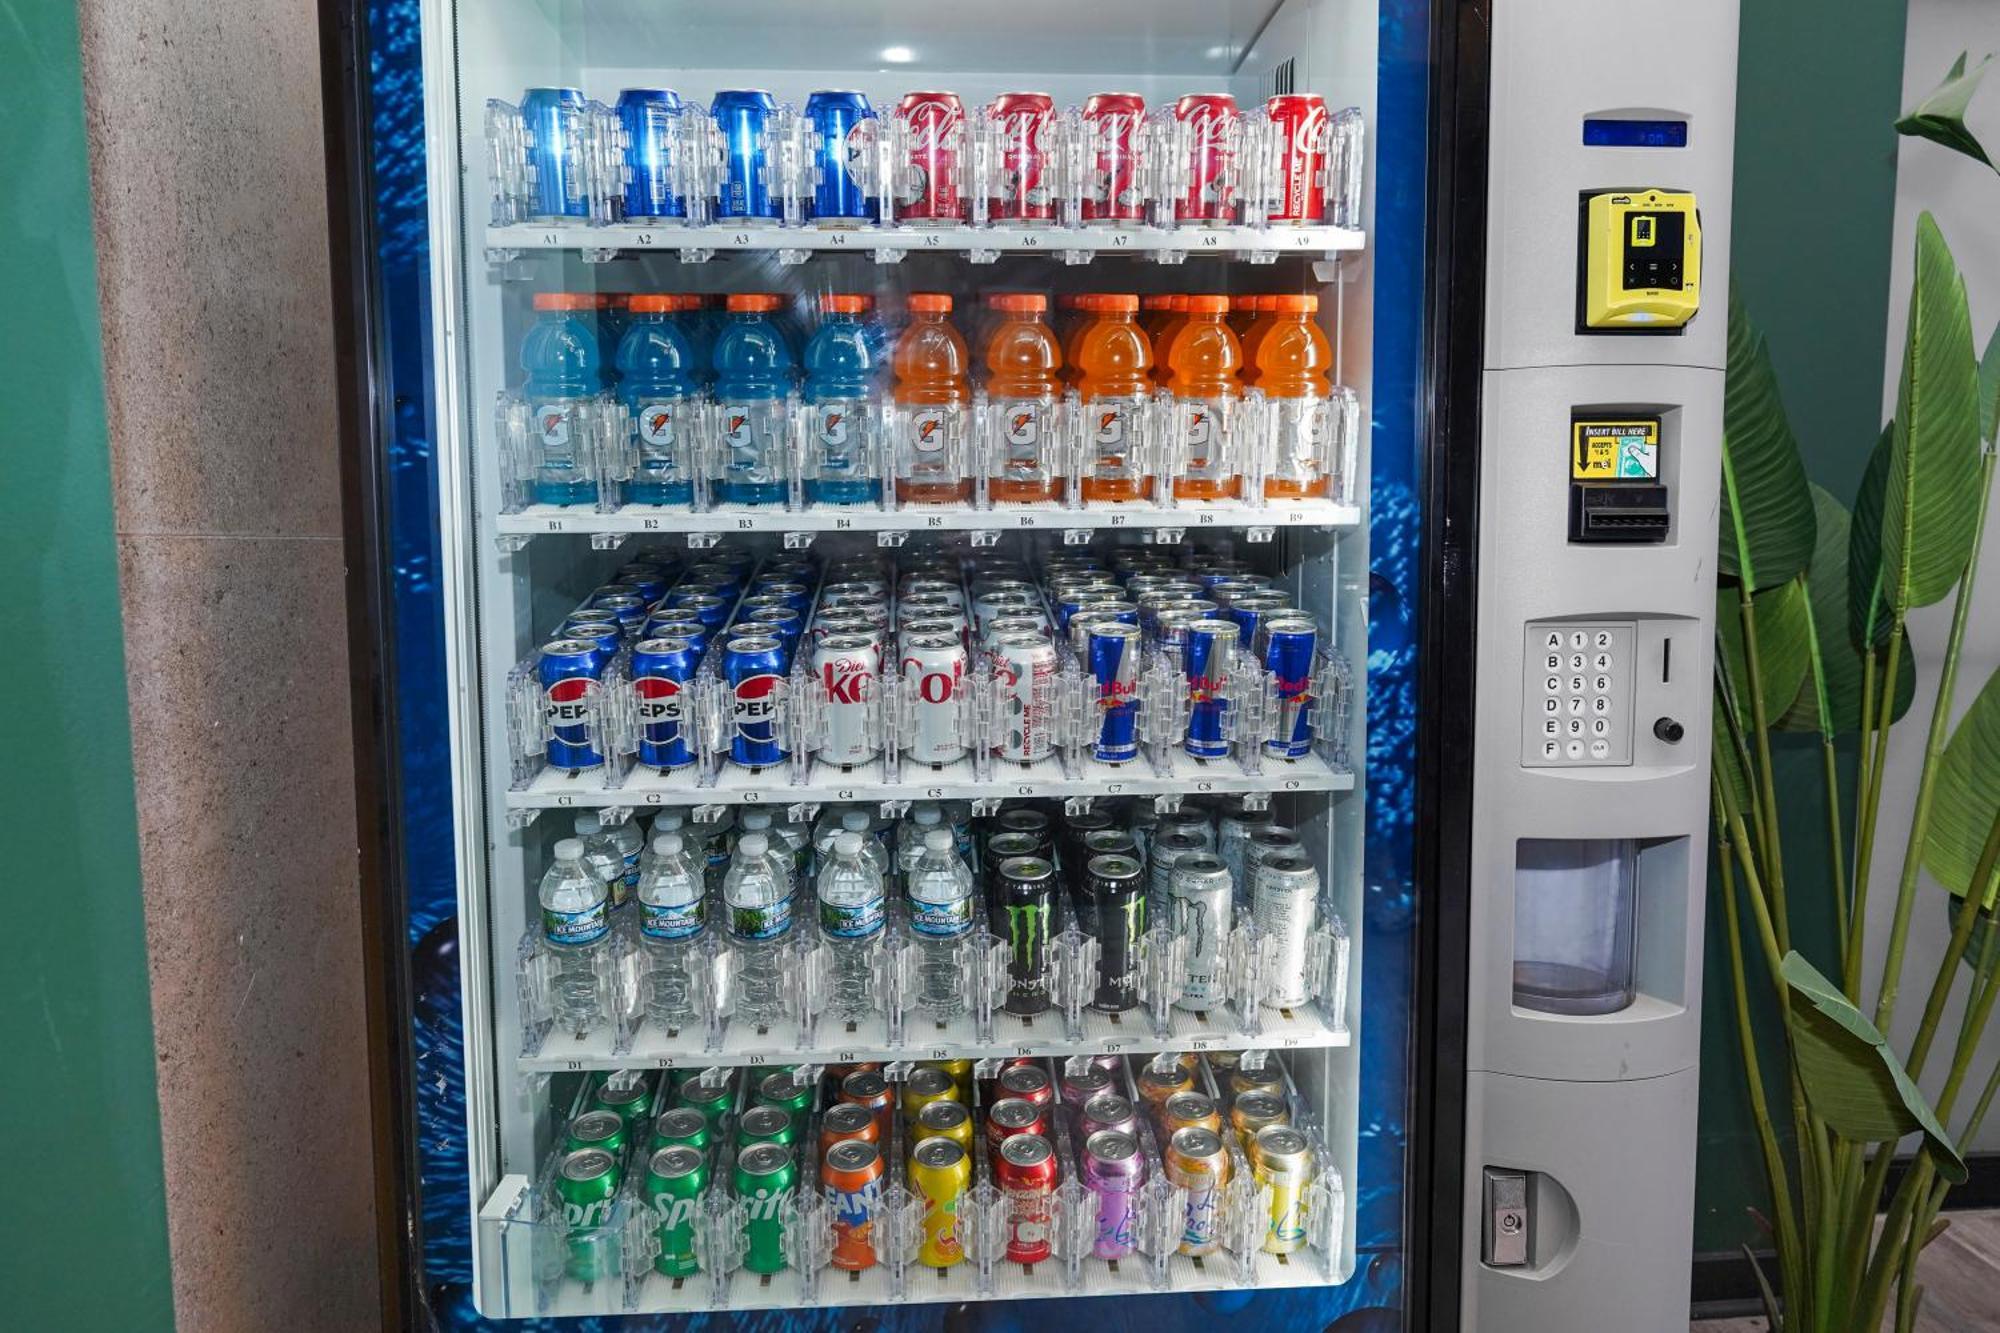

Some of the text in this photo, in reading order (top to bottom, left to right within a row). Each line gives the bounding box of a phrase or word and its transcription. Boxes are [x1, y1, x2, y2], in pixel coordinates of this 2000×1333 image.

[544, 235, 556, 244] A1
[637, 235, 651, 244] A2
[735, 235, 748, 244] A3
[831, 235, 844, 244] A4
[926, 236, 939, 246] A5
[1024, 237, 1036, 245] A6
[1114, 236, 1127, 245] A7
[1203, 237, 1216, 245] A8
[1586, 427, 1646, 436] INSERT BILL HERE
[929, 517, 941, 527] B5
[1021, 517, 1034, 526] B6
[1112, 516, 1124, 525] B7
[1201, 515, 1212, 524] B8
[549, 521, 562, 531] B1
[645, 520, 658, 529] B2
[739, 520, 752, 529] B3
[837, 520, 850, 529] B4
[1549, 634, 1607, 646] A 1 2
[1548, 655, 1606, 668] B 3 4
[1547, 677, 1605, 690] C 5 6
[1547, 699, 1605, 711] D 7 8
[1546, 720, 1604, 733] E 9 0
[1546, 743, 1555, 754] F
[1109, 785, 1121, 793] C7
[1198, 783, 1211, 791] C8
[1286, 781, 1299, 789] C9
[928, 789, 941, 798] C5
[1019, 787, 1032, 795] C6
[647, 794, 660, 804] C2
[744, 793, 758, 802] C3
[839, 792, 852, 800] C4
[559, 797, 571, 805] C1
[1108, 1044, 1120, 1053] D7
[1194, 1042, 1206, 1050] D8
[934, 1051, 946, 1059] D5
[1018, 1048, 1031, 1056] D6
[751, 1056, 764, 1065] D3
[840, 1053, 853, 1062] D4
[569, 1061, 581, 1070] D1
[660, 1059, 672, 1067] D2
